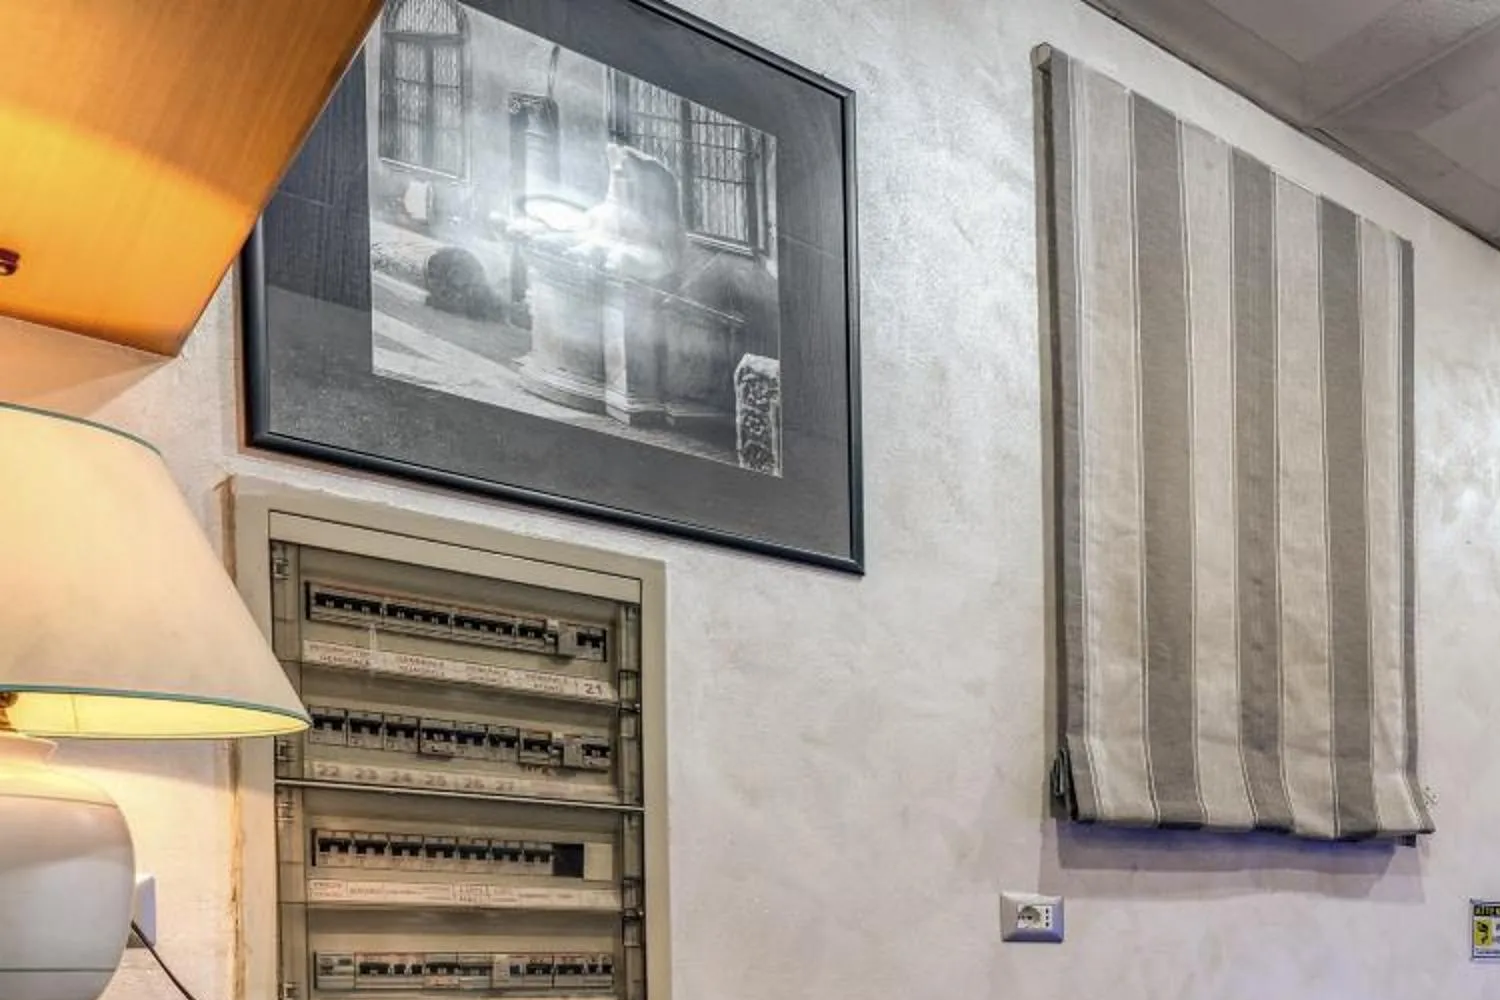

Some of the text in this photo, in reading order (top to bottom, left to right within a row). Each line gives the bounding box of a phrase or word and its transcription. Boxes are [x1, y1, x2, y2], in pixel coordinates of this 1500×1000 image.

[584, 683, 604, 696] 21
[318, 763, 339, 777] 22
[355, 767, 378, 780] 23
[390, 770, 412, 783] 24
